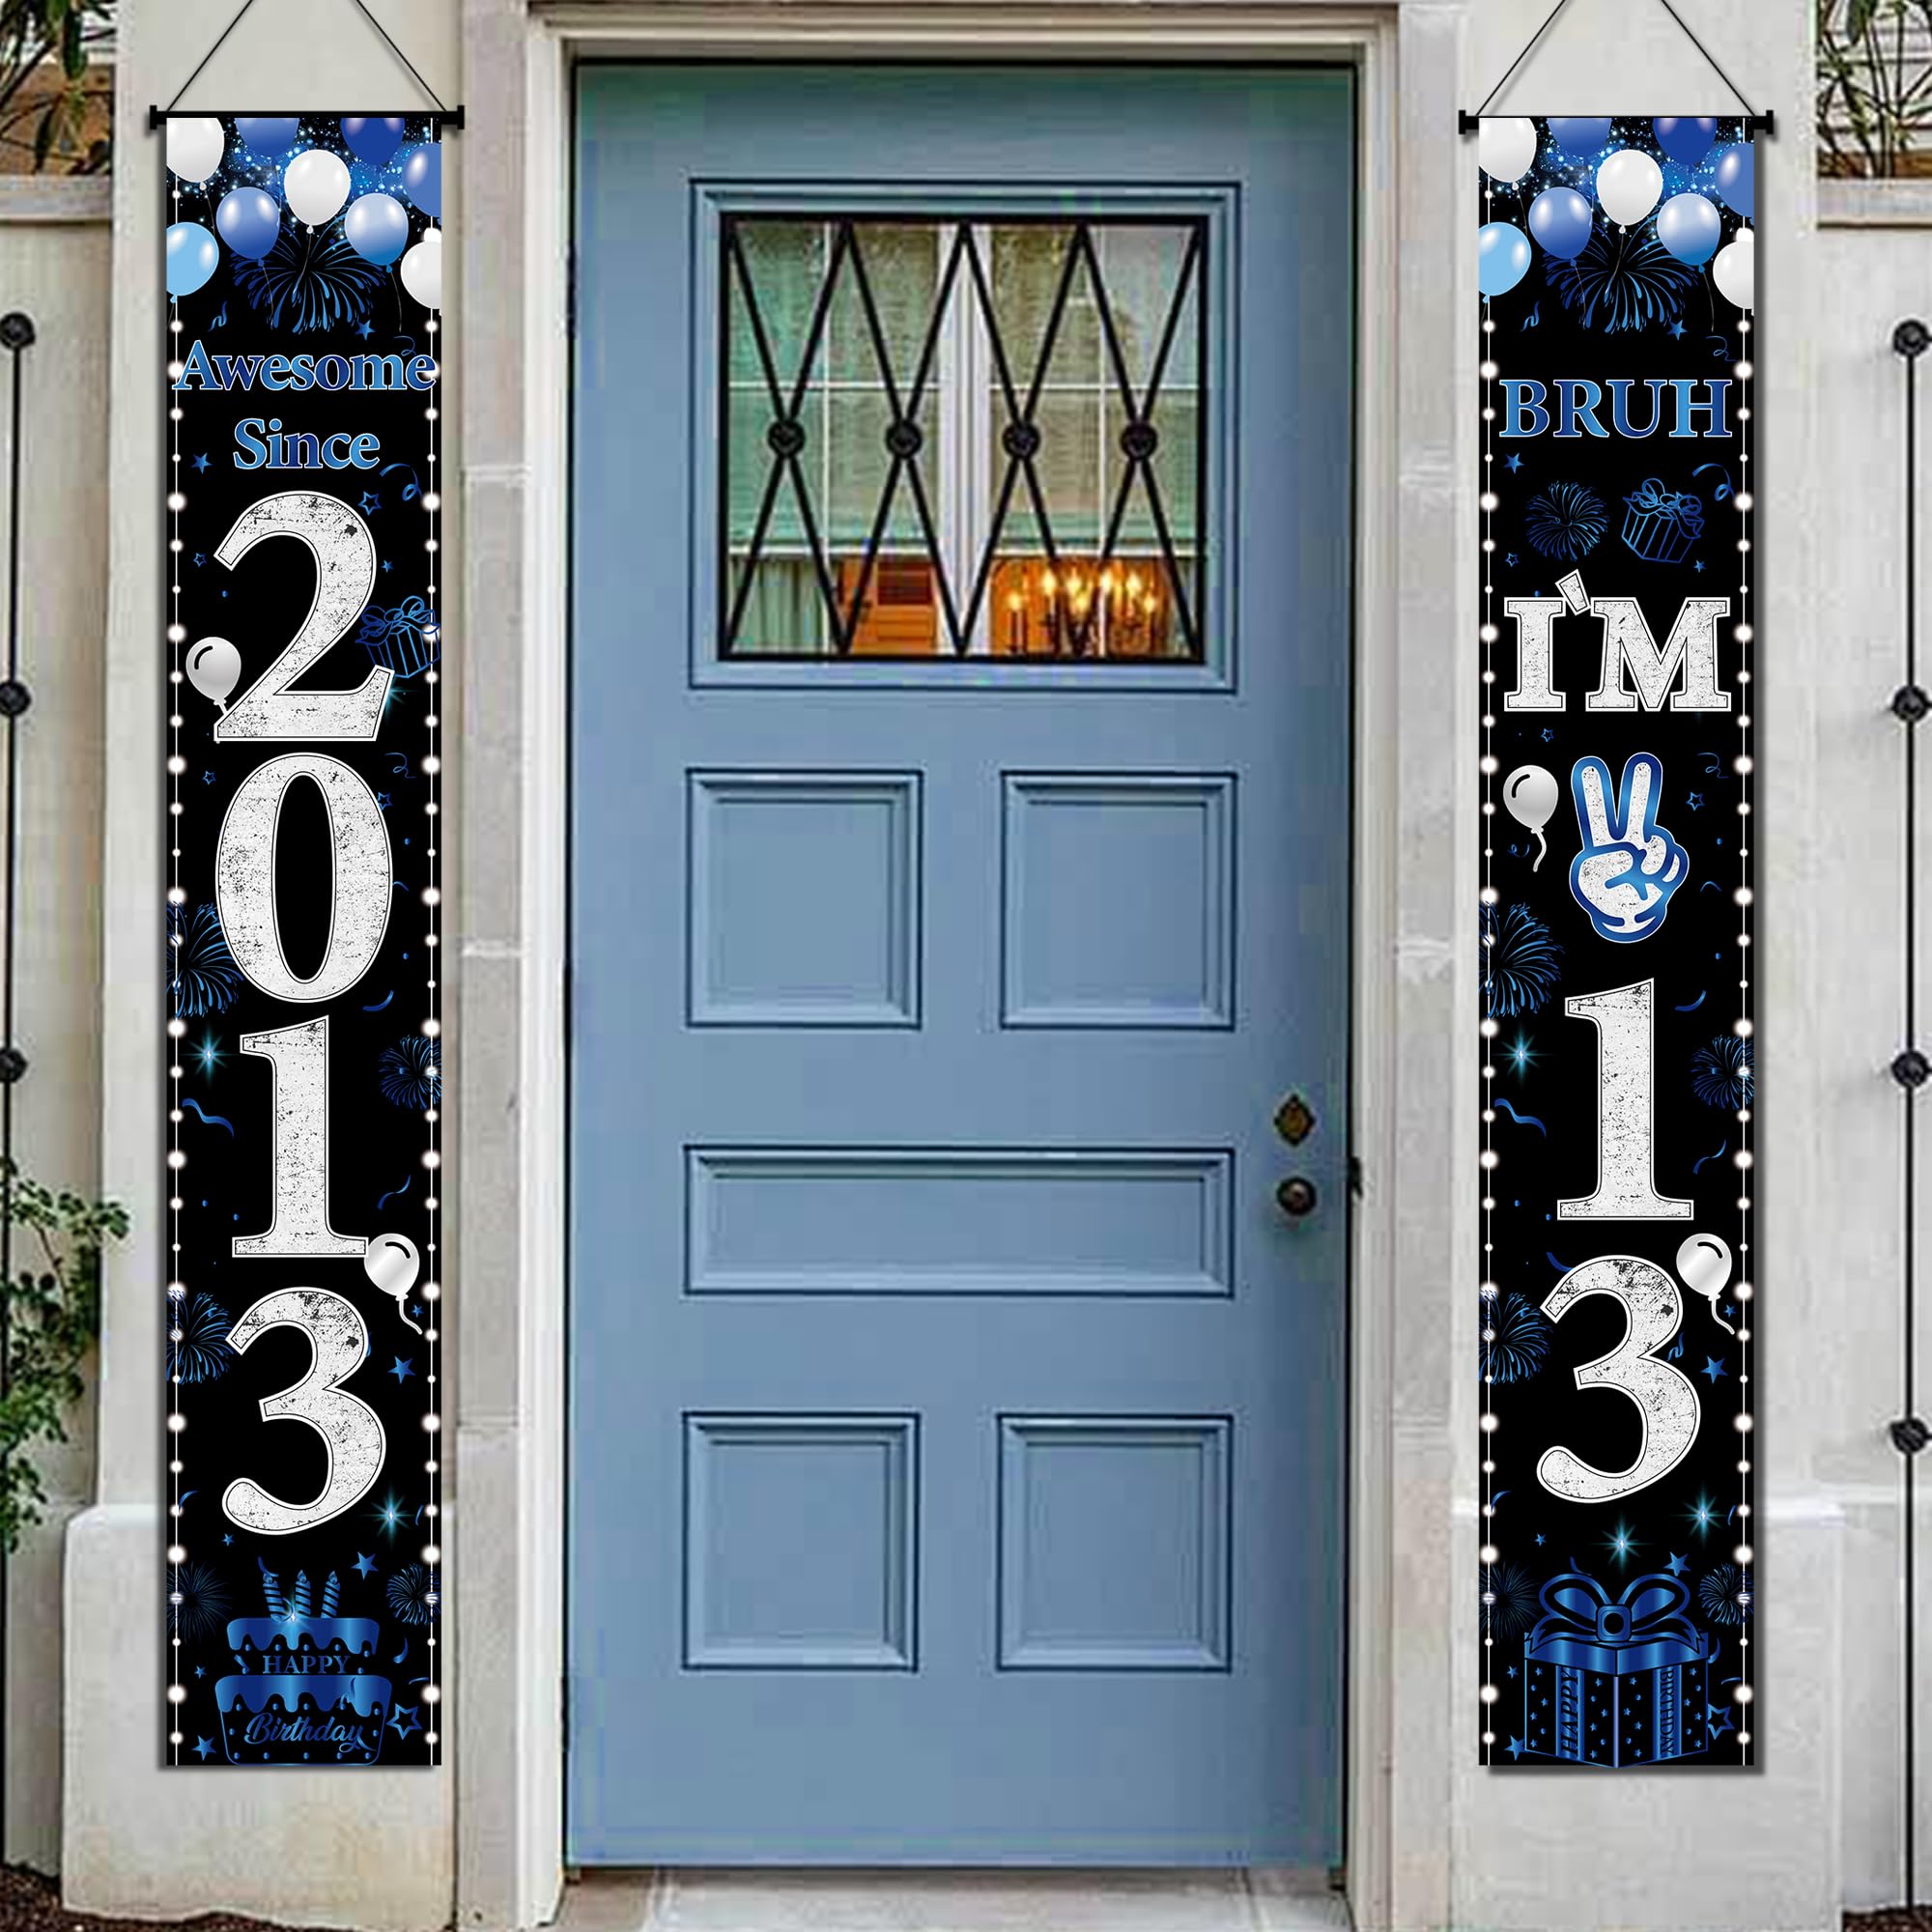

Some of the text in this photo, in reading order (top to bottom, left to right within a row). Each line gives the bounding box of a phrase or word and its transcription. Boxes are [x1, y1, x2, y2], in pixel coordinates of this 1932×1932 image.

[172, 339, 438, 391] Awesome
[1498, 379, 1733, 439] BRUH
[232, 417, 382, 470] Since
[262, 1655, 351, 1675] HAPPY
[243, 1712, 379, 1753] Birthday
[1561, 1666, 1578, 1756] HAPPY
[1660, 1668, 1675, 1756] BIRTHDAY
